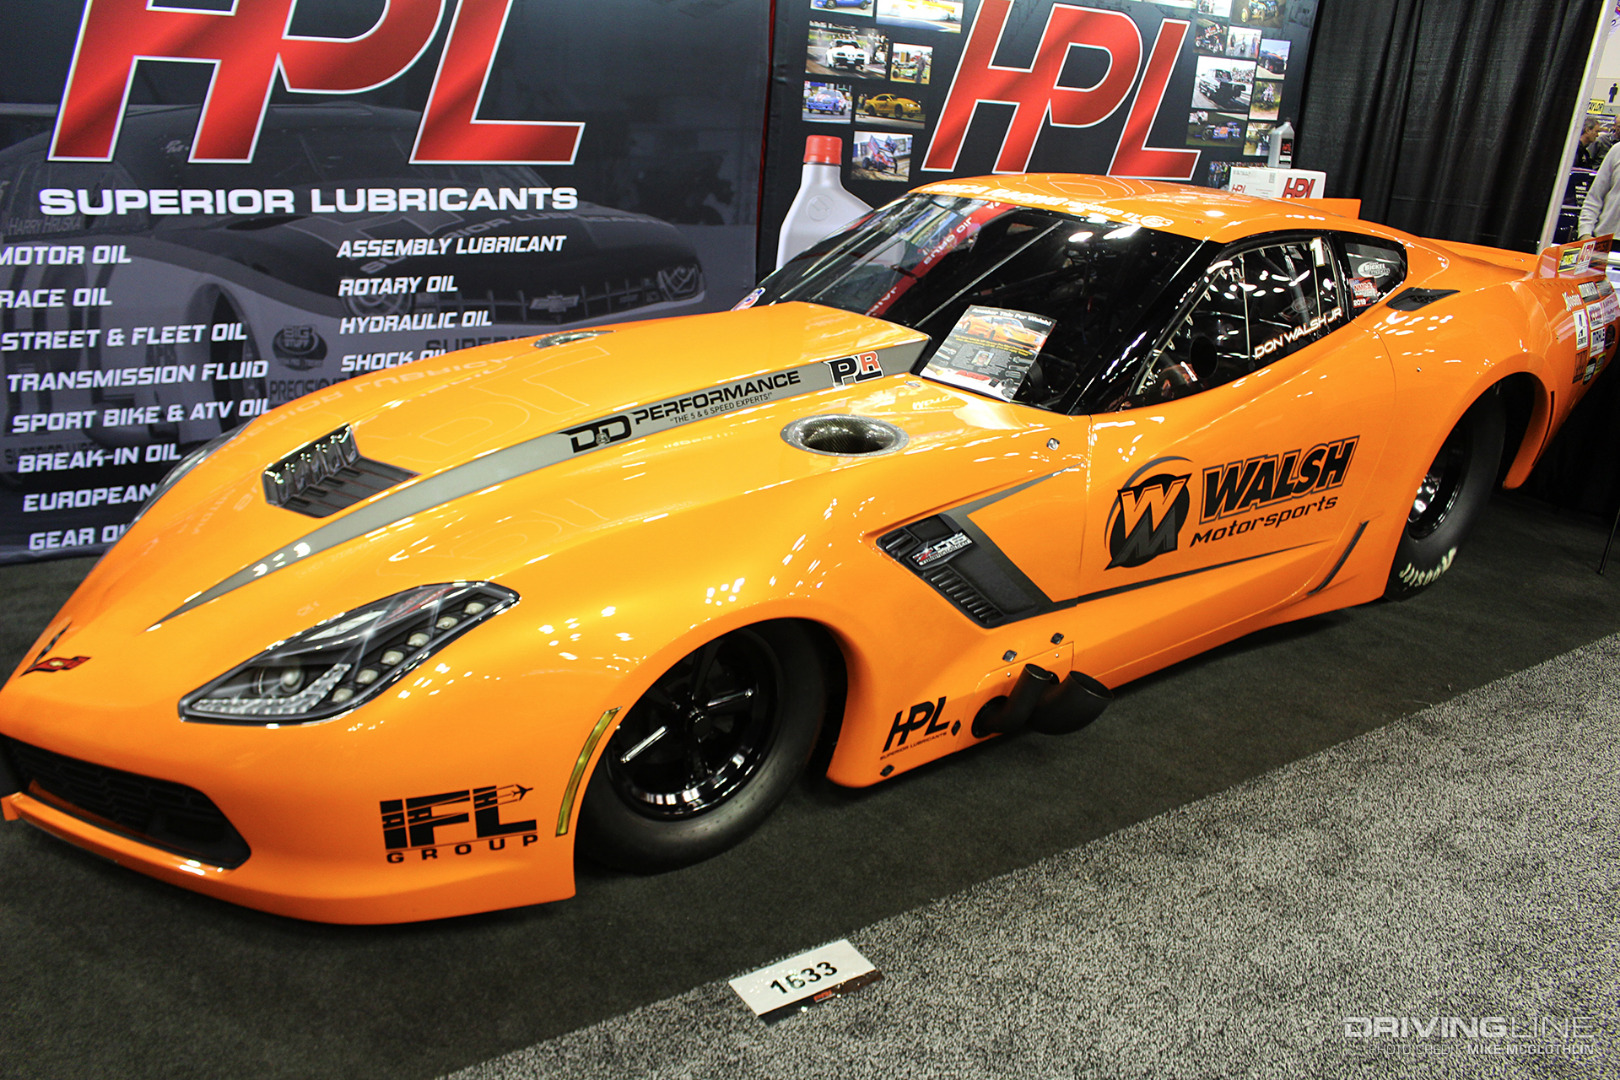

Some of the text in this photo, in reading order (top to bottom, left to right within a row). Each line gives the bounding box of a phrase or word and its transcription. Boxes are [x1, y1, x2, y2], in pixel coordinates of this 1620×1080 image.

[47, 0, 586, 165] HPL
[921, 0, 1201, 181] HPL
[39, 187, 579, 216] SUPERIOR LUBRICANTS
[0, 244, 132, 266] MOTOR OIL
[336, 234, 567, 258] ASSEMBLY LUBRICANT
[1309, 236, 1325, 268] 1
[0, 287, 113, 309] RACE OIL
[338, 274, 458, 297] ROTARY OIL
[1, 322, 248, 352] STREET & FLEET OIL
[340, 310, 493, 335] HYDRAULIC OIL
[1253, 306, 1343, 360] DON WALSH JR
[340, 351, 415, 373] SHOCK
[420, 348, 448, 362] OI
[7, 364, 196, 393] TRANSMISSION
[201, 360, 269, 382] FLUID
[629, 370, 801, 425] PERFORMANCE
[710, 402, 735, 415] SPEED
[12, 398, 272, 433] SPORT BIKE & ATV OIL
[17, 446, 139, 473] BREAK-IN
[145, 443, 182, 462] OIL
[1199, 435, 1361, 526] WALSH
[22, 482, 158, 513] EUROPEAN
[28, 523, 129, 551] GEAR OI
[1190, 496, 1339, 548] Motorsports
[882, 696, 950, 753] HPL
[386, 834, 538, 864] GROUP
[769, 961, 838, 995] 1633
